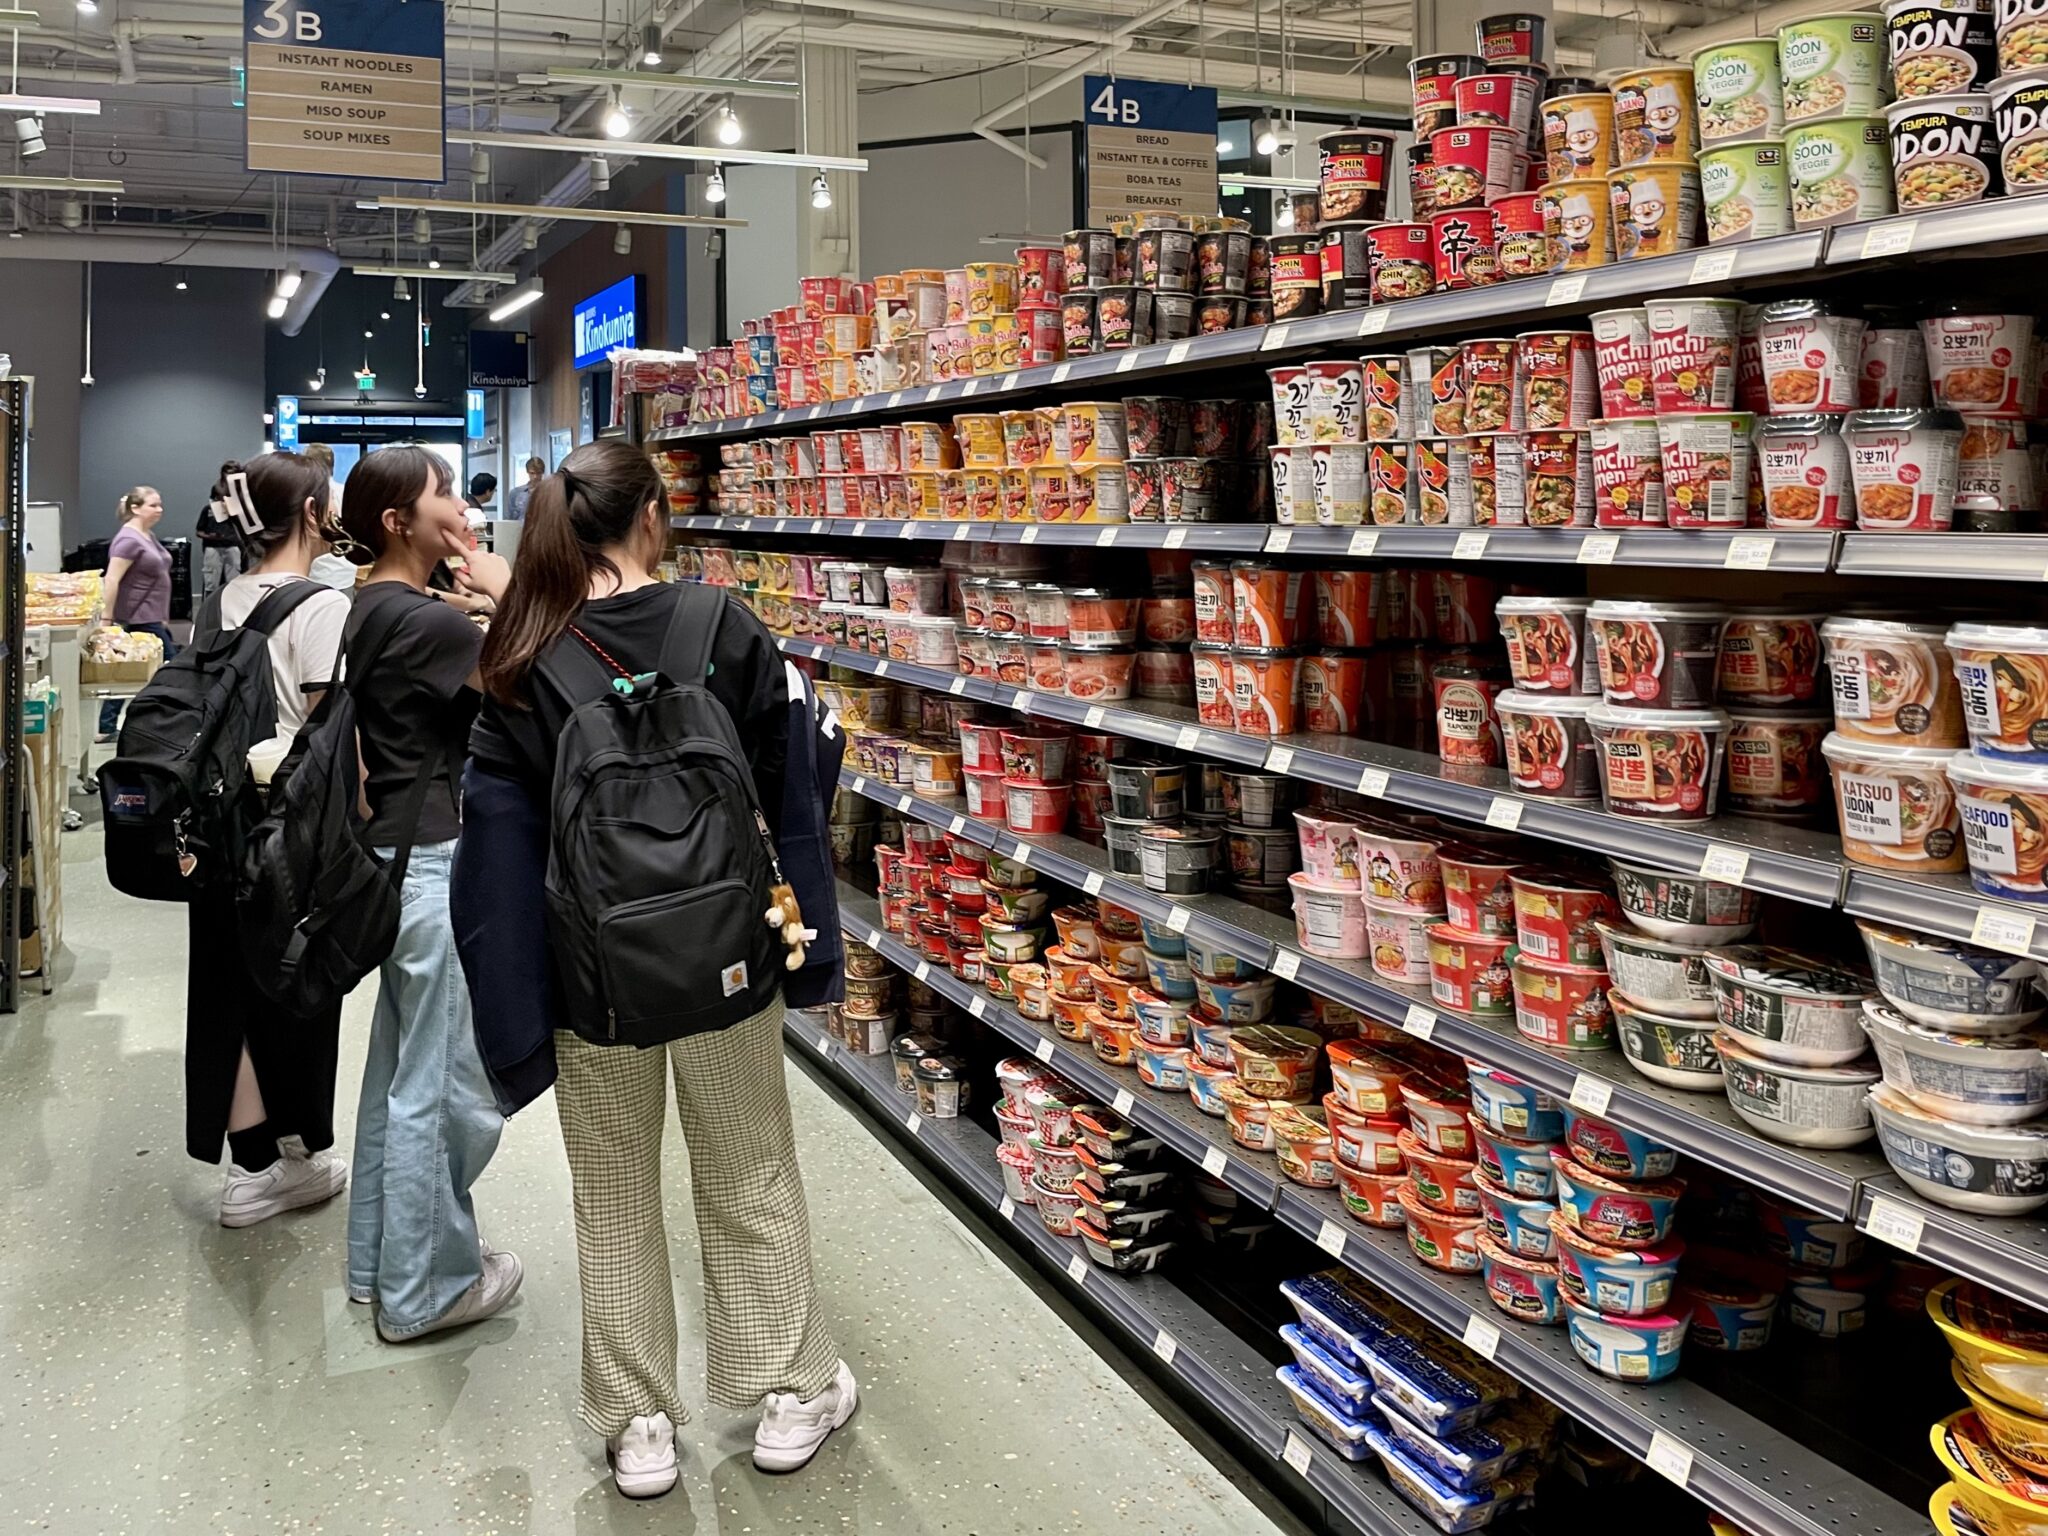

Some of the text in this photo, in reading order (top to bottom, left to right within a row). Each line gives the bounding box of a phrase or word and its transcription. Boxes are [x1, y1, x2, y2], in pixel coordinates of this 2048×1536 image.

[254, 0, 322, 41] 3B
[1892, 10, 1932, 28] TEMPURA
[1889, 16, 1968, 59] DON
[1785, 41, 1821, 59] SOON
[278, 53, 413, 73] INSTANT NOODLES
[1788, 56, 1818, 69] VEGGIE
[1708, 64, 1746, 80] SOON
[321, 81, 372, 94] RAMEN
[1711, 78, 1744, 90] VEGGIE
[1091, 85, 1140, 124] 4B
[306, 105, 386, 120] MISO SOUP
[1901, 116, 1947, 132] TEMPURA
[304, 130, 390, 145] SOUP MIXES
[1136, 135, 1169, 145] BREAD
[1794, 143, 1832, 161] SOON
[1097, 152, 1208, 168] INSTANT TEA & COFFEE
[1338, 160, 1363, 168] SHIN
[1798, 159, 1830, 171] VEGGIE
[1126, 174, 1181, 186] BOBA TEAS
[1126, 195, 1182, 206] BREAKFAST
[1441, 218, 1479, 275] 辛
[1504, 245, 1527, 254] SHIN
[1279, 260, 1300, 268] SHIN
[1381, 271, 1403, 279] SHIN
[585, 305, 635, 354] Kinokuniya
[1765, 338, 1797, 355] 요뽀끼
[1943, 334, 1984, 349] 요뽀끼
[472, 375, 527, 387] Kinokuniya
[1767, 453, 1797, 467] 요뽀끼
[1856, 450, 1889, 464] 요뽀끼
[998, 655, 1025, 663] TOPOK
[1447, 700, 1479, 708] ORIGINAL
[1444, 707, 1483, 722] 라뽀끼
[1608, 758, 1647, 782] 짬뽕
[1842, 780, 1893, 802] KATSUO
[1845, 796, 1874, 814] UDON
[1847, 811, 1892, 826] NOODLE BOWL
[1966, 822, 1988, 842] DON
[1984, 843, 2005, 855] BOWL
[2005, 931, 2026, 943] $3.49
